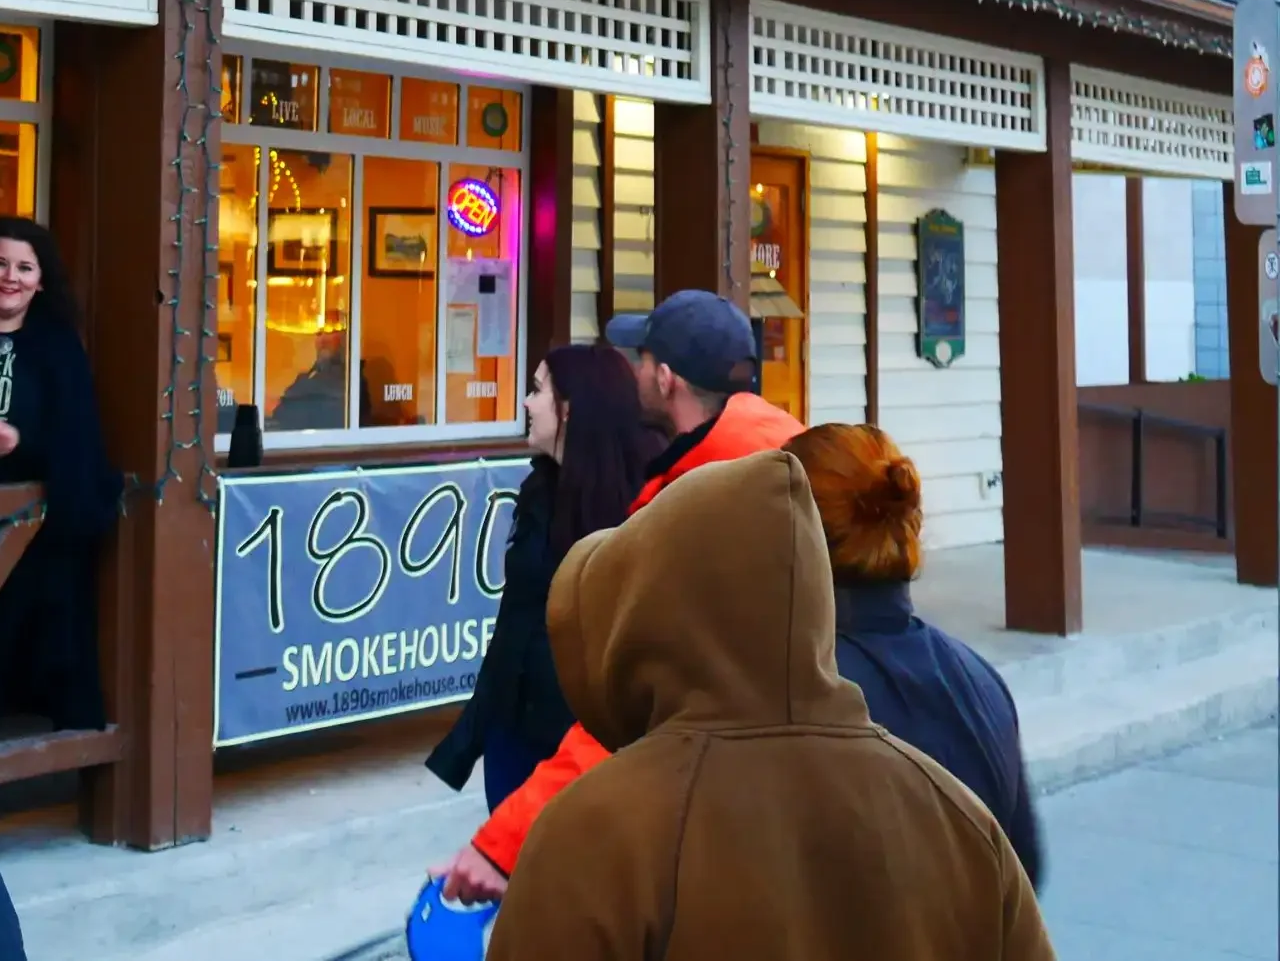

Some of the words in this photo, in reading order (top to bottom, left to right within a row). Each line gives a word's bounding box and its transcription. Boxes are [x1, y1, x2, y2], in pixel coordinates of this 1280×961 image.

[271, 100, 299, 122] LIVE
[343, 107, 377, 129] LOCAL
[452, 187, 497, 232] OPEN
[383, 384, 413, 402] LUNCH
[236, 481, 520, 634] 1890
[282, 616, 497, 691] SMOKEHOUSE
[285, 672, 477, 723] www.1890smokehouse.co
